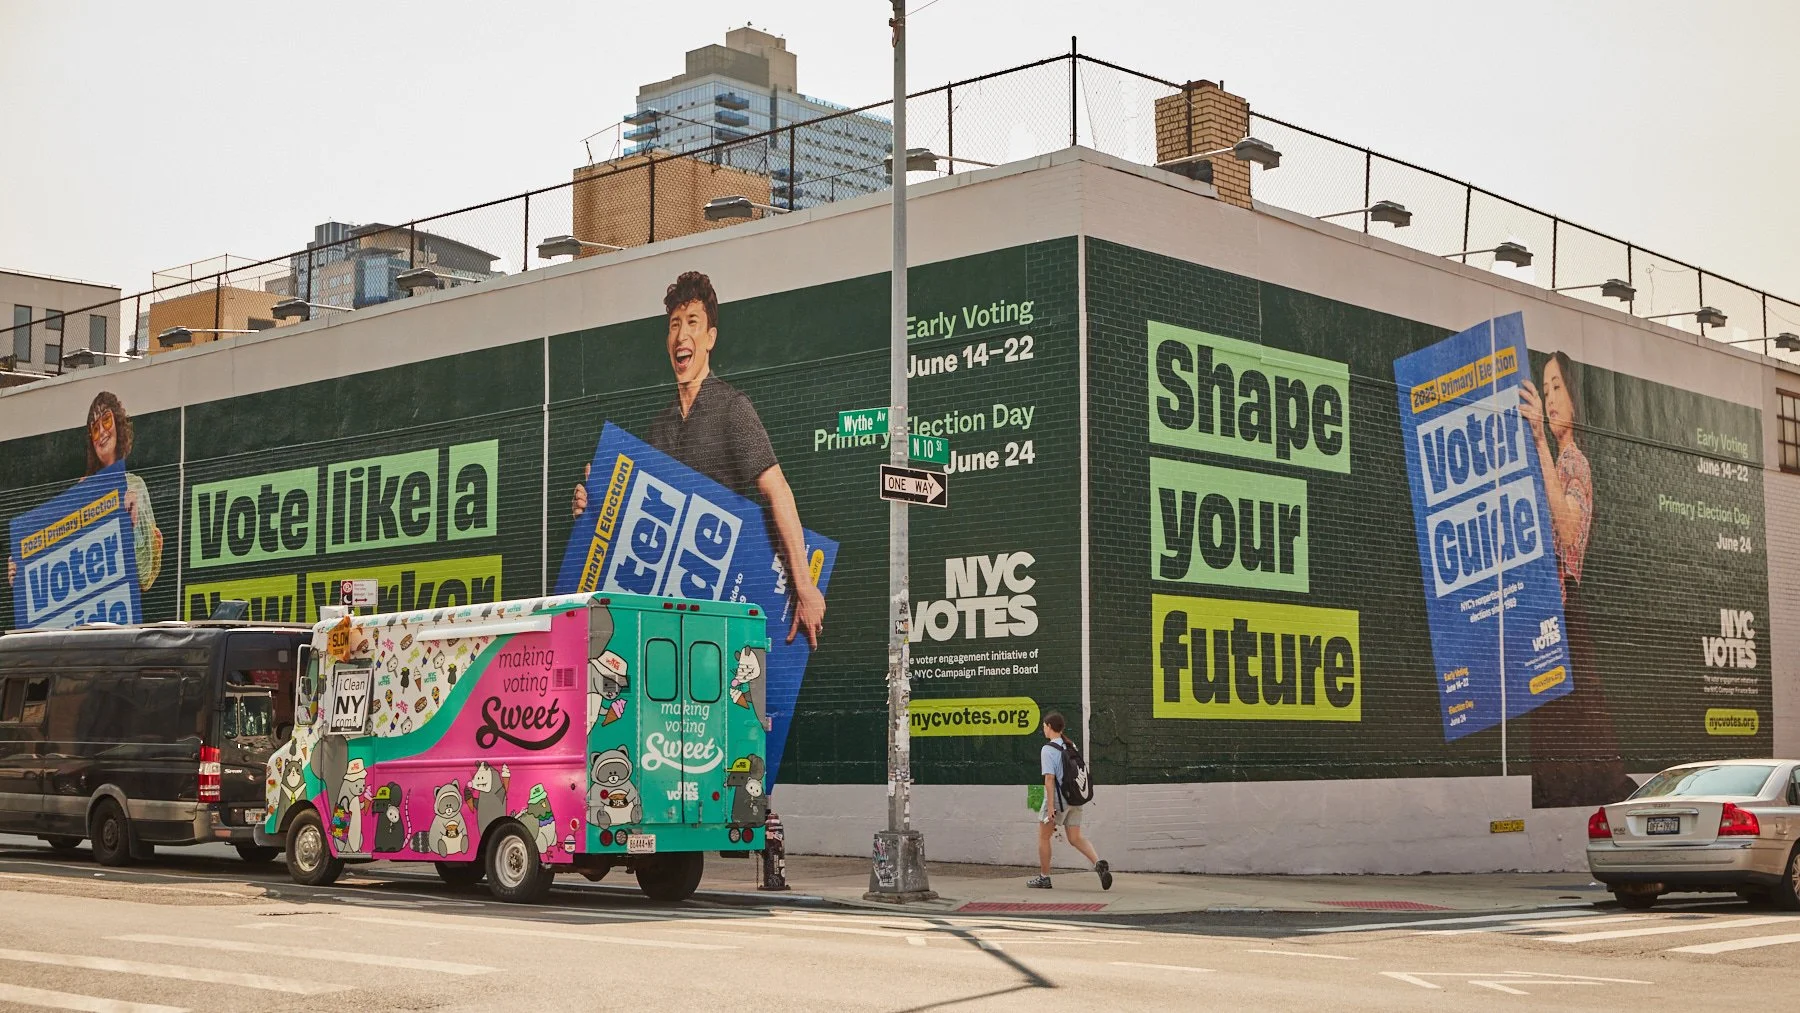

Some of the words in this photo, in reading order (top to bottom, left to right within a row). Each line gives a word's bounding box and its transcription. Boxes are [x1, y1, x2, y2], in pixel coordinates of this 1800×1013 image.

[906, 312, 957, 340] Early
[962, 300, 1034, 329] Voting
[907, 353, 958, 378] June
[1414, 387, 1436, 408] 2025
[1441, 372, 1474, 398] Primary
[1479, 354, 1515, 380] Eletion
[1156, 339, 1343, 460] Shape
[844, 415, 873, 436] Wythe
[877, 411, 886, 421] Av
[993, 404, 1035, 430] Day
[913, 438, 919, 456] N
[923, 440, 933, 459] 10
[936, 440, 942, 451] St
[1422, 405, 1519, 495] Voter
[1697, 428, 1718, 452] Early
[1720, 434, 1748, 459] Voting
[943, 450, 999, 474] June
[1005, 440, 1035, 466] 24
[1697, 457, 1720, 477] June
[600, 461, 629, 534] Election
[888, 477, 906, 491] ONE
[915, 480, 934, 494] WAY
[198, 484, 309, 560] Vote
[332, 464, 431, 545] like
[454, 463, 488, 532] a
[1659, 494, 1695, 520] Primary
[1698, 501, 1733, 523] Election
[1733, 507, 1750, 530] Day
[23, 535, 43, 554] 2025
[48, 518, 78, 542] Primary
[83, 496, 118, 522] Election
[1158, 487, 1301, 580] your
[1434, 493, 1537, 585] Guide
[1716, 533, 1739, 551] June
[1740, 536, 1752, 554] 24
[29, 532, 118, 612] Voter
[946, 551, 1036, 598] NYC
[909, 594, 1039, 642] VOTES
[1539, 616, 1559, 635] NYC
[1720, 609, 1755, 639] NYC
[332, 632, 349, 648] SLOW
[1532, 629, 1561, 652] VOTES
[1702, 636, 1756, 669] VOTES
[498, 645, 554, 671] making
[916, 655, 938, 665] voter
[939, 652, 990, 665] engagement
[991, 649, 1027, 661] initiative
[1029, 648, 1039, 659] of
[1160, 610, 1355, 708] future
[344, 678, 365, 691] Clean
[503, 672, 548, 697] voting
[914, 669, 933, 679] NYC
[934, 667, 976, 679] Campaign
[978, 665, 1010, 676] Finance
[1012, 664, 1039, 675] Board
[335, 695, 365, 714] NY
[661, 701, 709, 720] making
[476, 696, 570, 750] Sweet
[665, 720, 705, 737] voting
[912, 707, 1030, 731] nycvotes.org
[1709, 715, 1755, 731] nycvotes.org
[641, 732, 724, 774] Sweet
[667, 790, 699, 800] VOTES
[677, 781, 698, 791] NYC
